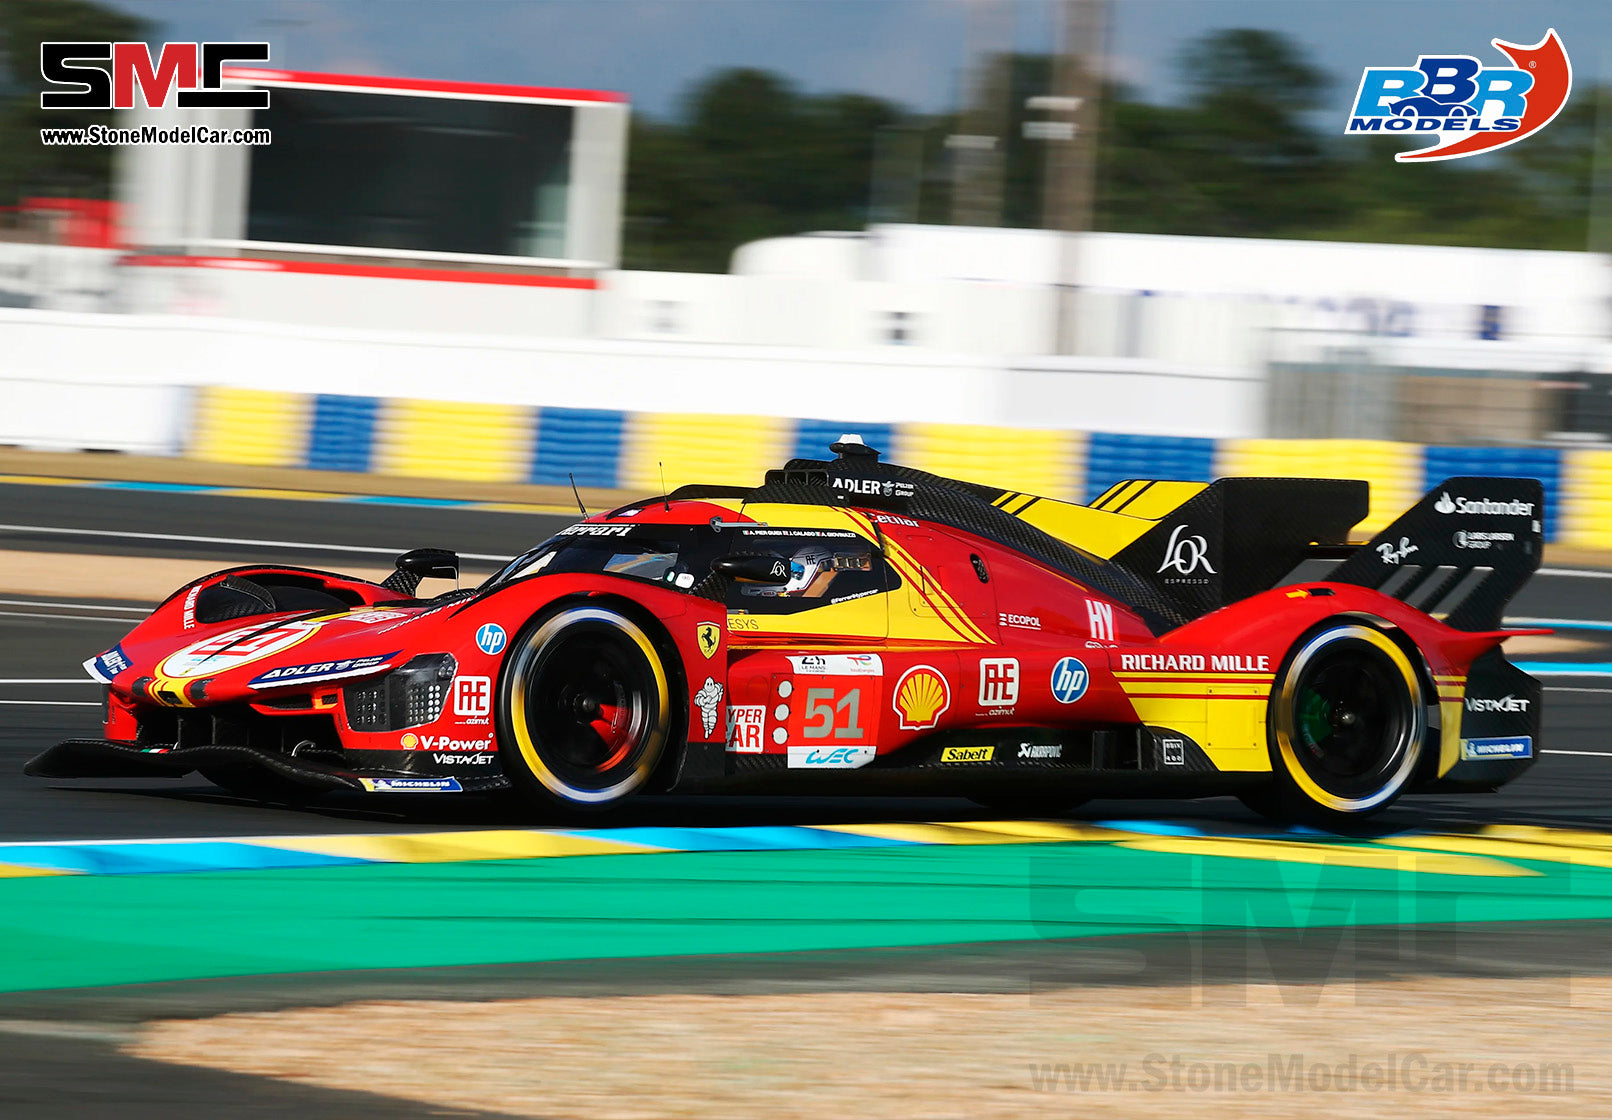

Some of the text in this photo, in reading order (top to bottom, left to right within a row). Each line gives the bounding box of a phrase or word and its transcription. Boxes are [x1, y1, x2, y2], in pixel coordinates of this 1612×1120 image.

[832, 478, 880, 495] ADLER
[1455, 496, 1535, 516] Santander
[727, 618, 759, 630] ESYS
[1008, 614, 1041, 626] ECOPOL
[1085, 599, 1114, 641] HY
[480, 623, 505, 654] hp
[261, 662, 331, 680] ADLER
[1120, 654, 1270, 672] RICHARD MILLE
[1054, 658, 1087, 702] hp
[728, 708, 763, 723] YPER
[803, 687, 864, 739] 51
[988, 706, 1015, 716] azimut
[466, 715, 490, 725] azimut
[420, 736, 491, 751] V-Power
[726, 724, 761, 748] AR
[806, 748, 859, 764] WEC
[947, 748, 988, 760] Sabelt
